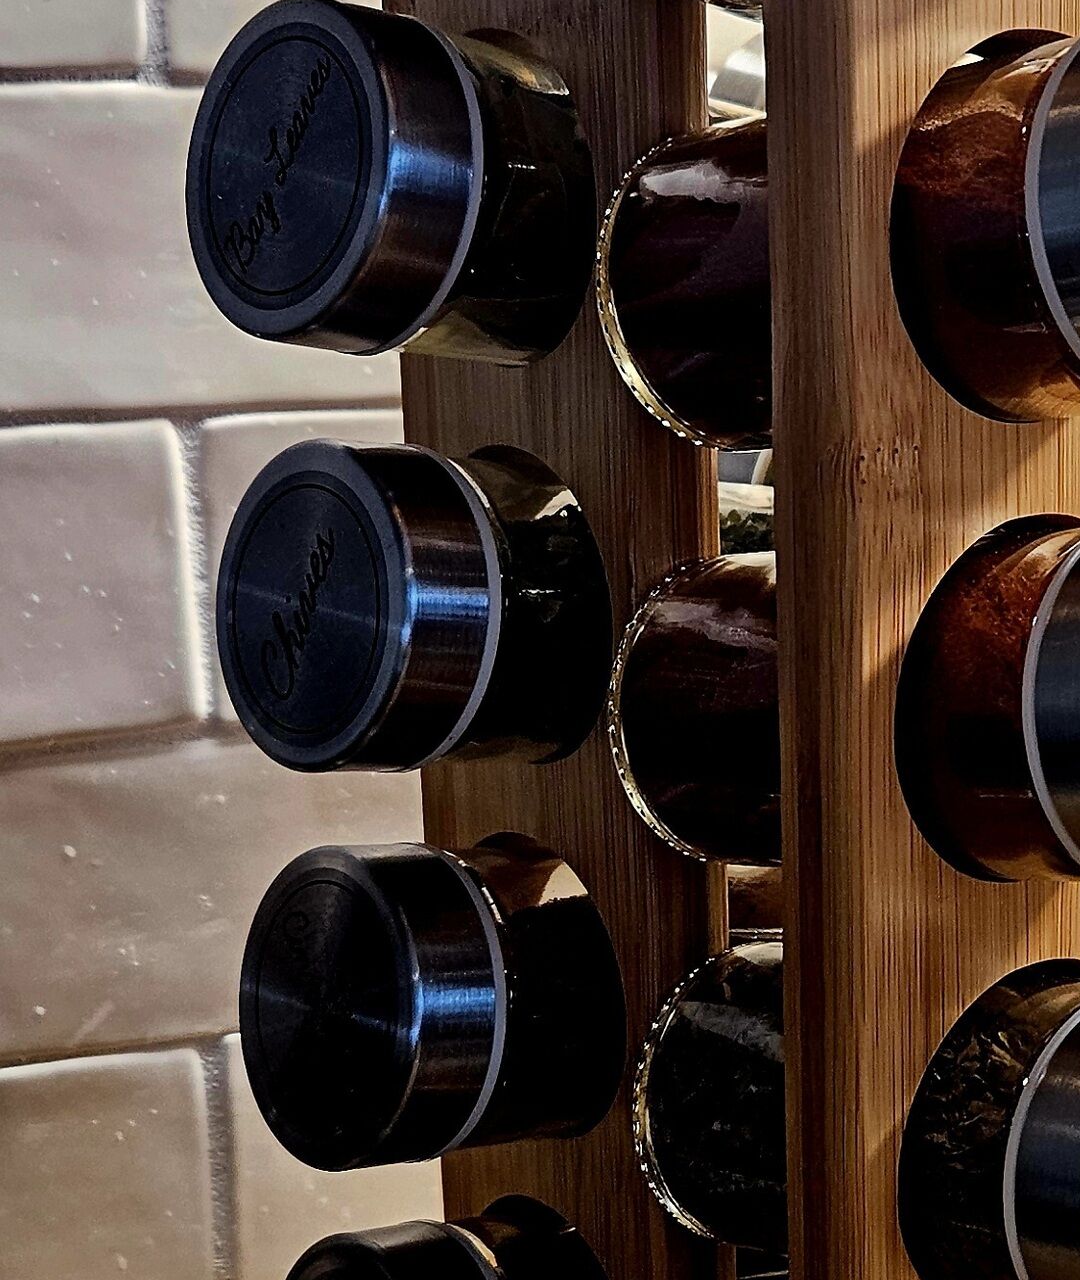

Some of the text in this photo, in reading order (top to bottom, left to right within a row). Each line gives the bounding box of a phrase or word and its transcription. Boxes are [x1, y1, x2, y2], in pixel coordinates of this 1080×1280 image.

[225, 54, 332, 273] Bay Leaves
[261, 528, 336, 700] Chives
